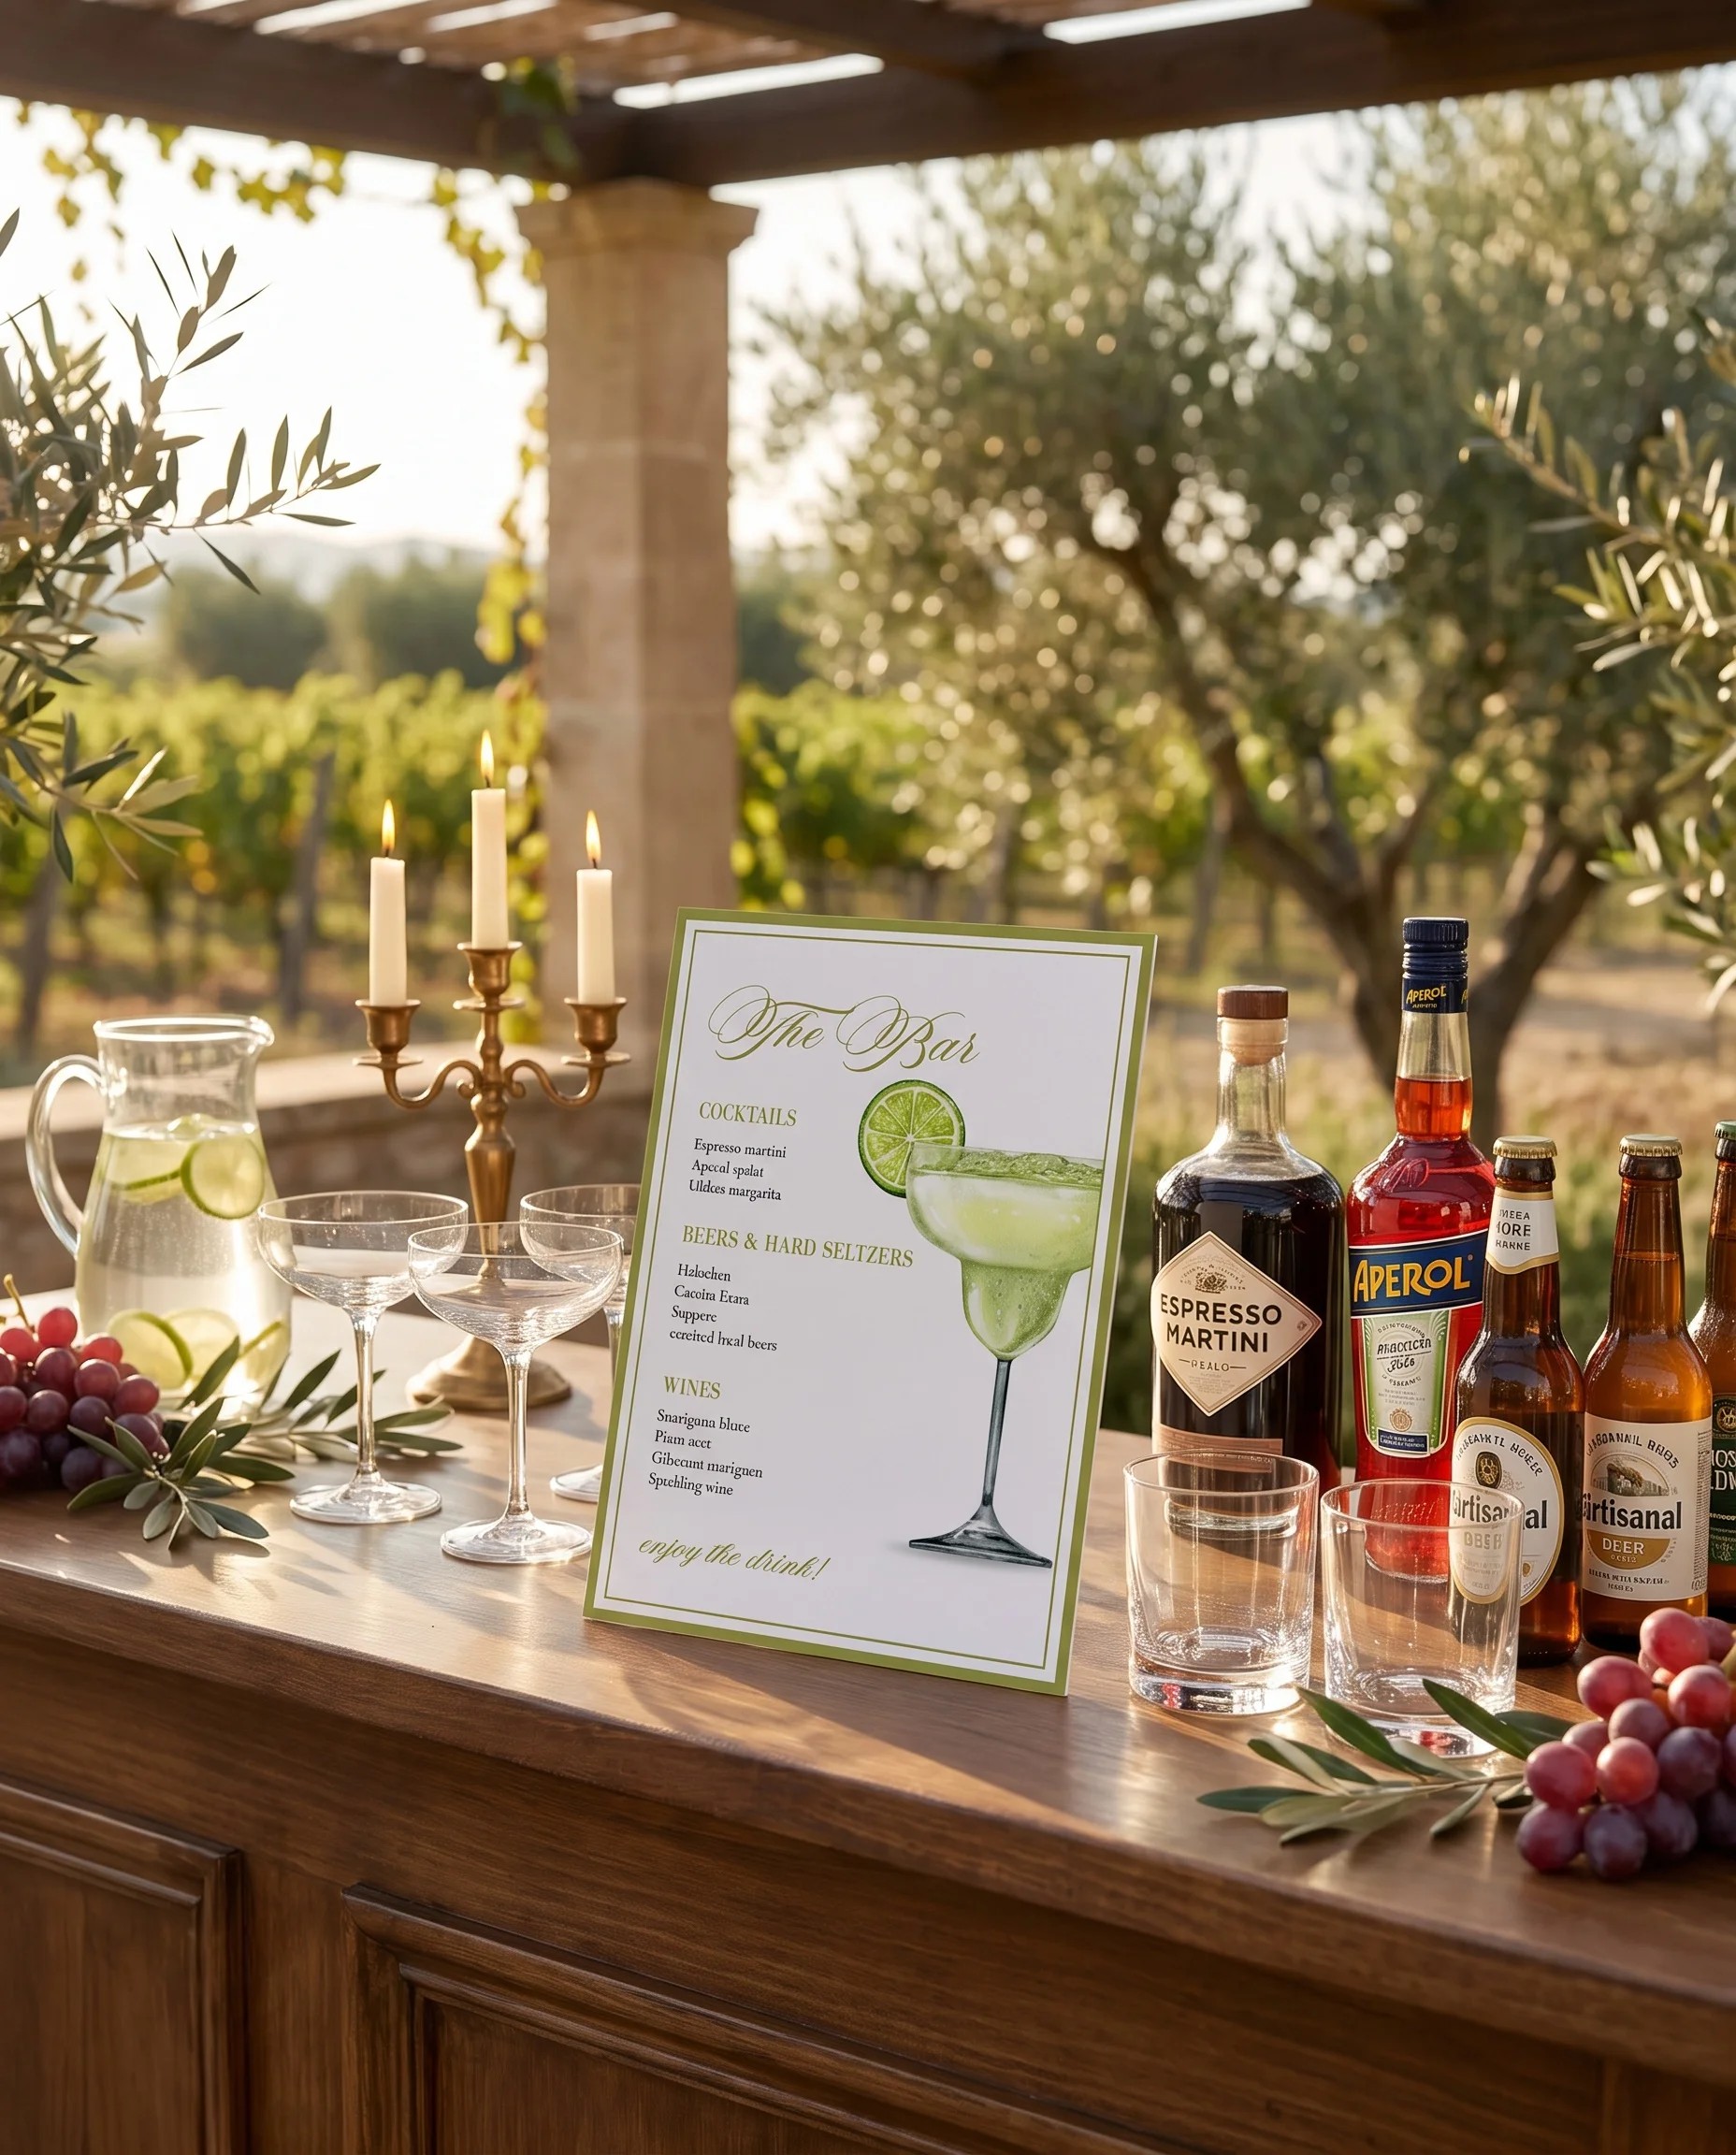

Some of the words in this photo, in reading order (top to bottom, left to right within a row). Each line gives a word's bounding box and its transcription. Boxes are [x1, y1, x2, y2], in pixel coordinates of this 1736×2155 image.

[708, 985, 855, 1060] The
[836, 995, 979, 1072] Bar
[699, 1101, 797, 1127] COCKTAILS
[694, 1137, 742, 1156] Espresso
[745, 1146, 787, 1159] martini
[729, 1187, 782, 1203] margarita
[682, 1224, 738, 1248] BEERS
[744, 1232, 758, 1251] &
[764, 1234, 817, 1256] HARD
[822, 1240, 914, 1268] SELTZERS
[1353, 1256, 1470, 1303] APEROL
[1161, 1293, 1282, 1325] ESPRESSO
[1166, 1322, 1268, 1353] MARTINI
[663, 1376, 721, 1400] WINES
[705, 1481, 733, 1496] wine
[639, 1539, 702, 1568] enjoy
[704, 1543, 742, 1566] the
[745, 1549, 832, 1581] drink!
[1602, 1537, 1645, 1555] DEER
